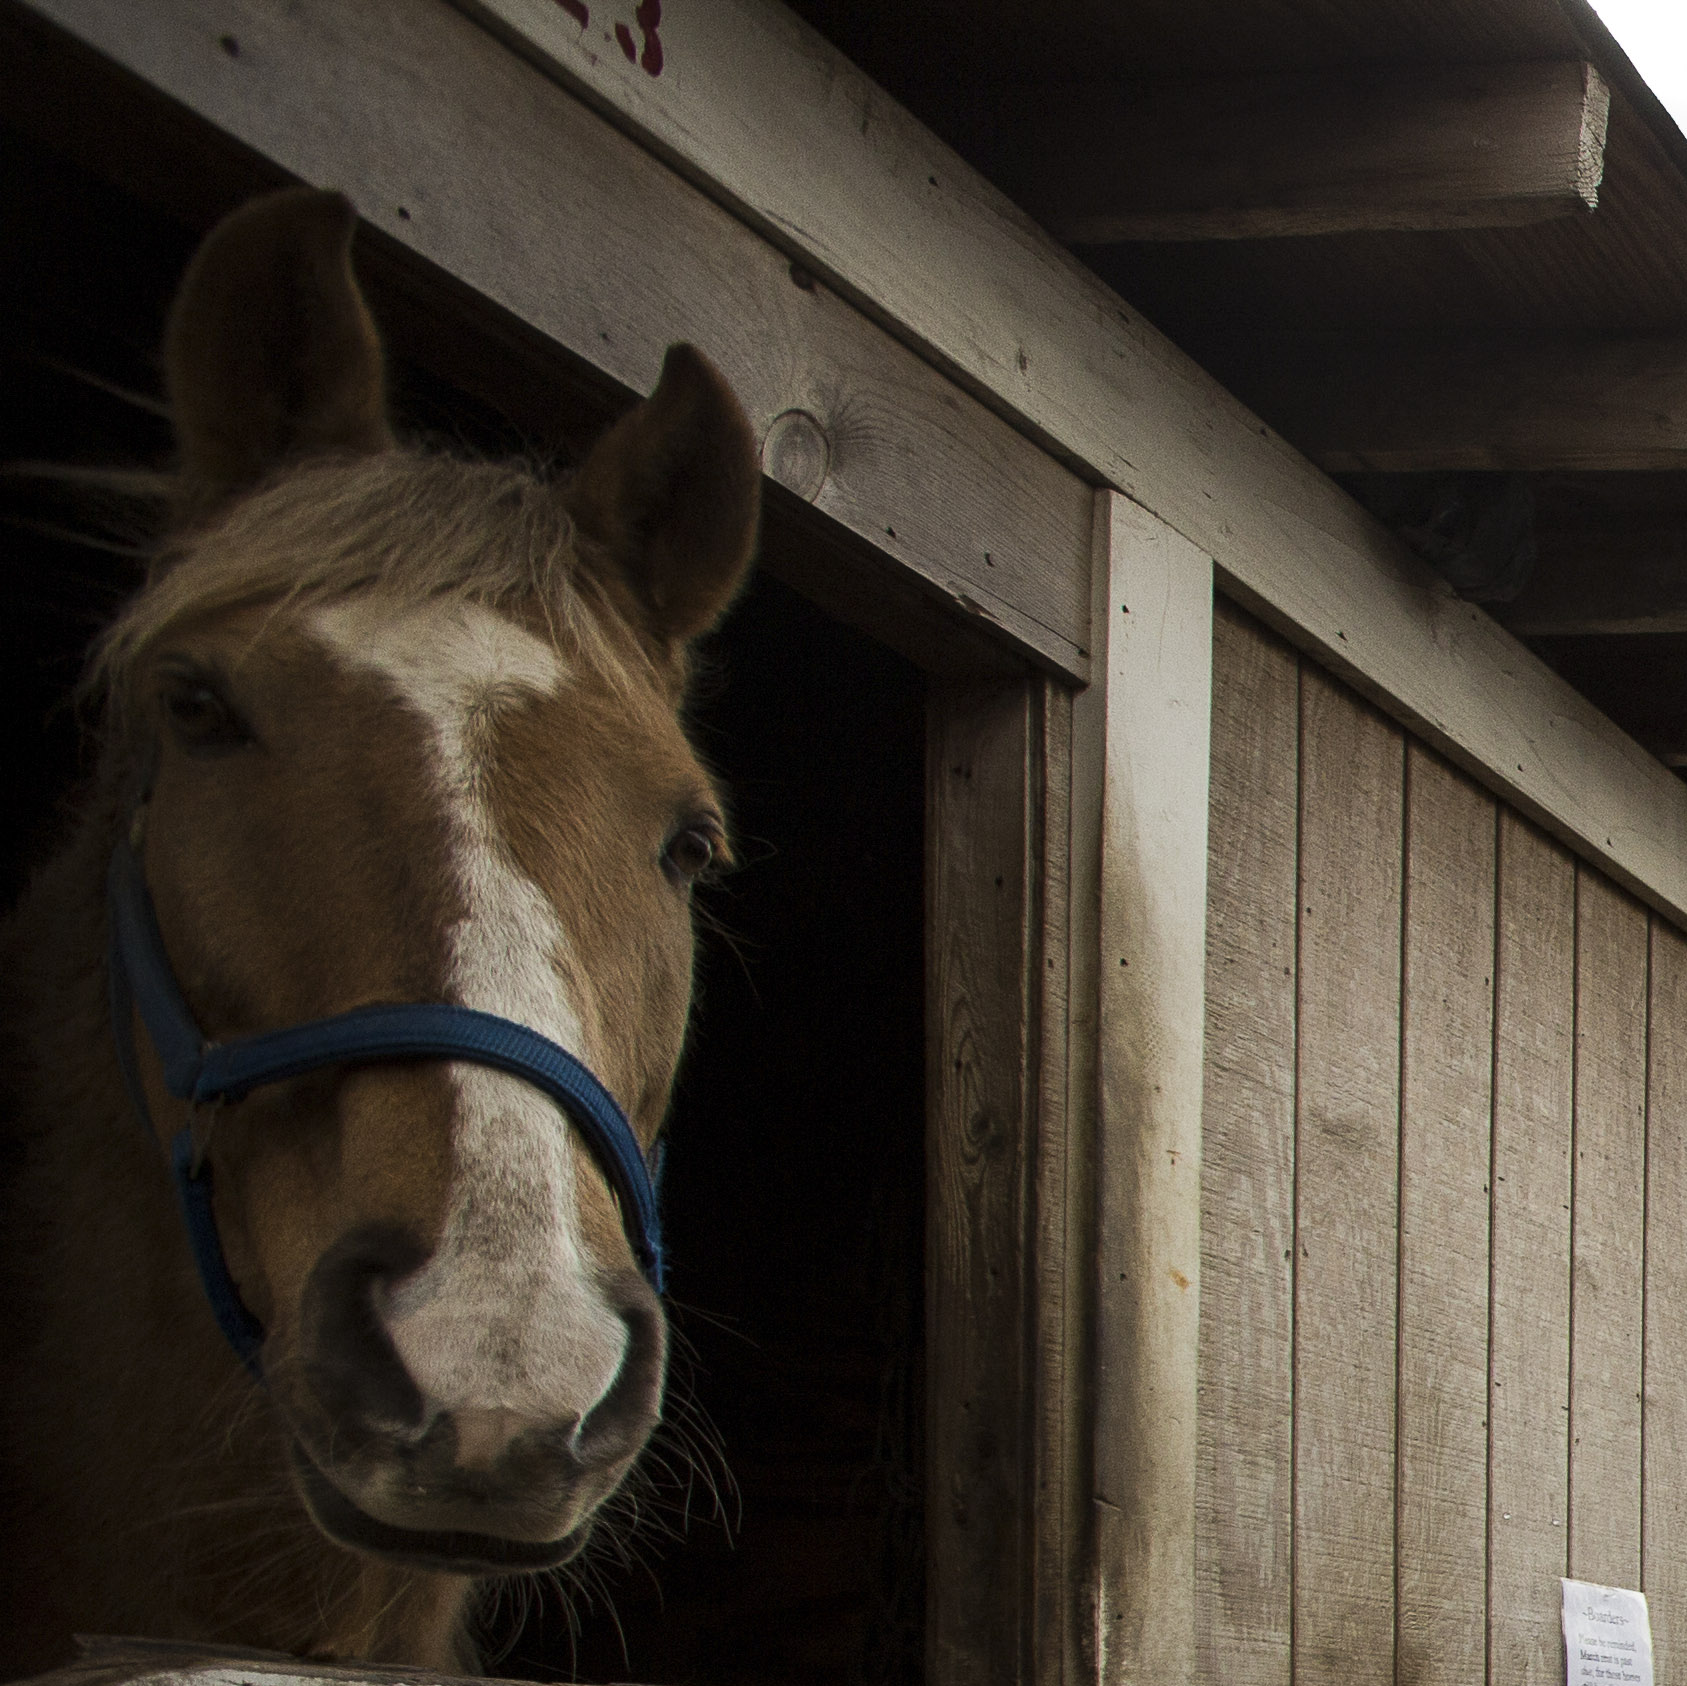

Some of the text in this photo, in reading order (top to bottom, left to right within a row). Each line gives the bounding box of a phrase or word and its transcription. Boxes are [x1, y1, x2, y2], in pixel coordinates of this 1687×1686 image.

[1580, 1649, 1600, 1661] March
[1600, 1655, 1612, 1663] rent
[1620, 1657, 1632, 1668] past
[1595, 1667, 1604, 1677] for
[1605, 1669, 1621, 1680] those
